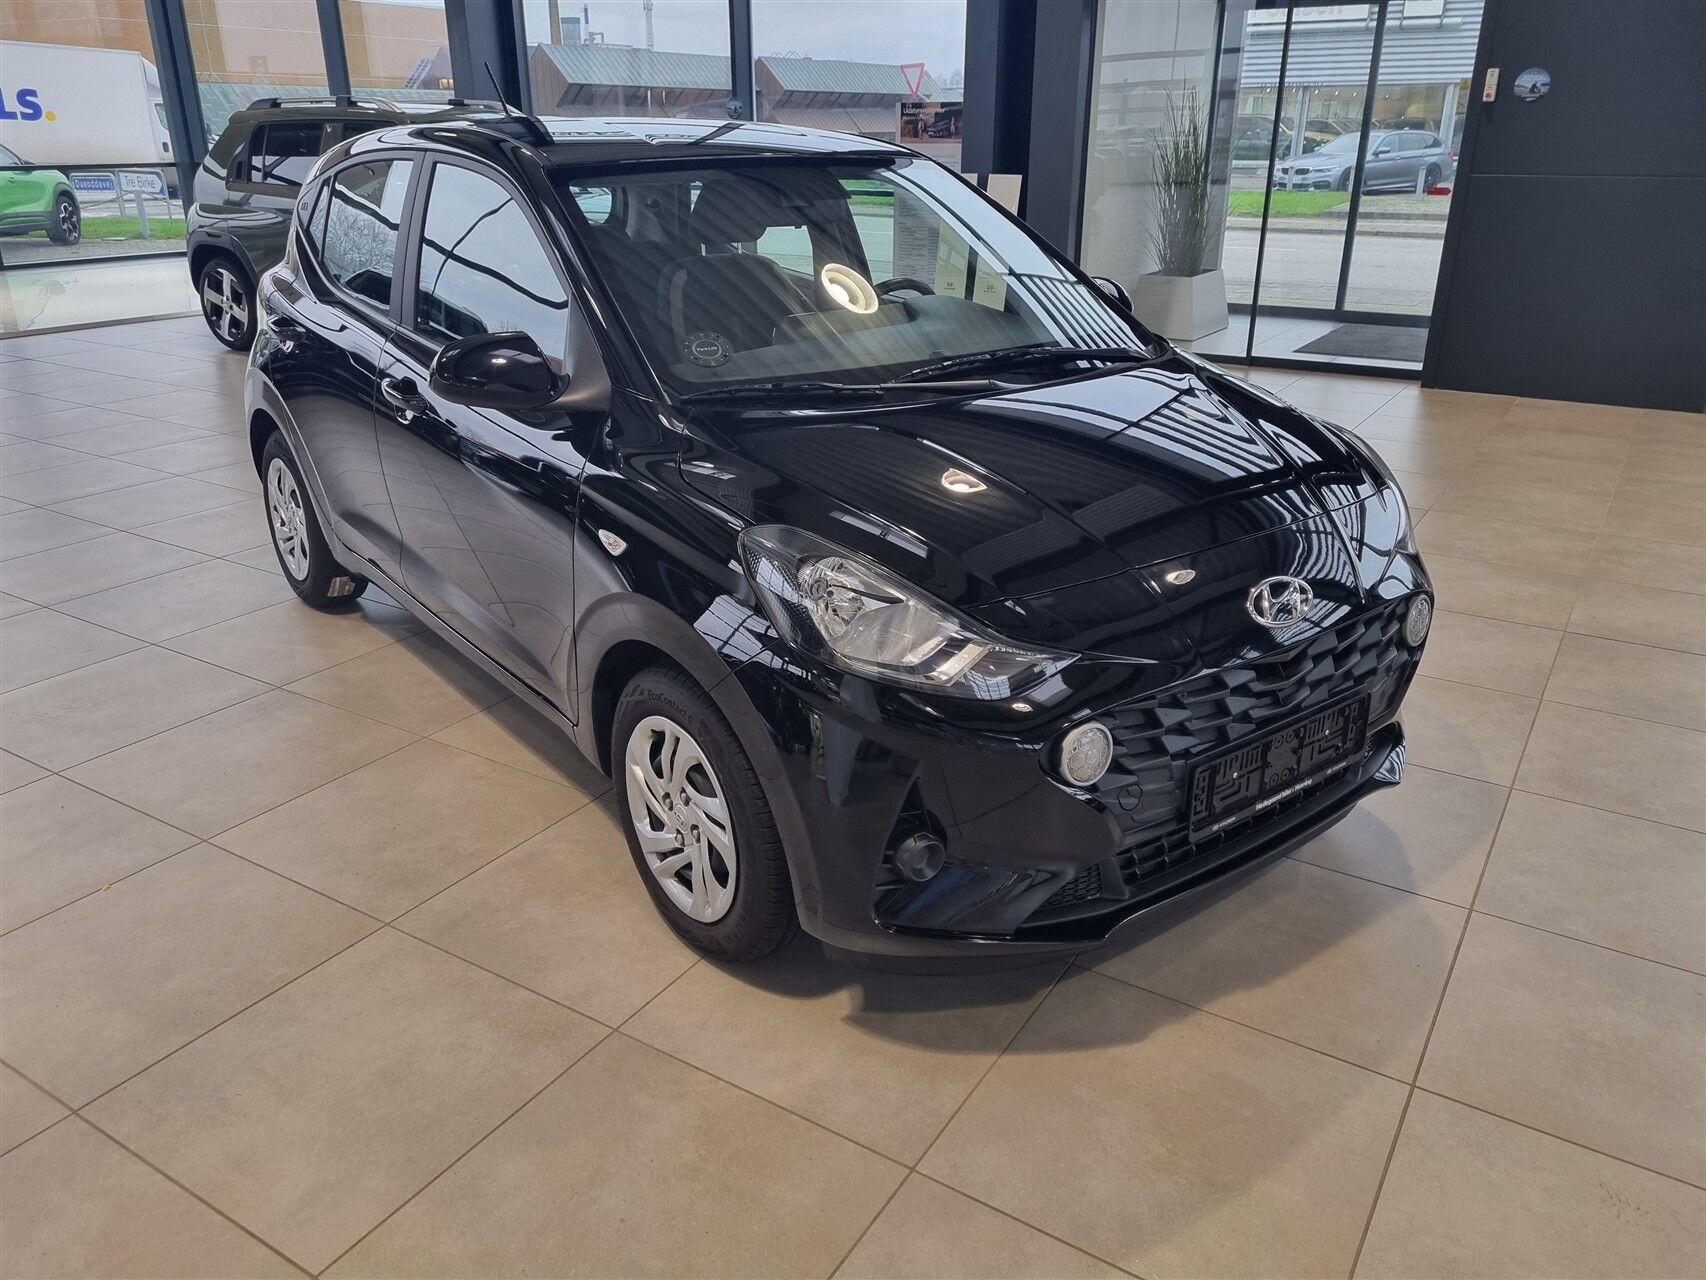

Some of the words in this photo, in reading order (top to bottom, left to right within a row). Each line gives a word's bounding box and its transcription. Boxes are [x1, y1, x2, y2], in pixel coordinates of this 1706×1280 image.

[124, 175, 136, 188] Tre
[136, 175, 156, 189] Birke
[647, 689, 687, 718] EcoContact
